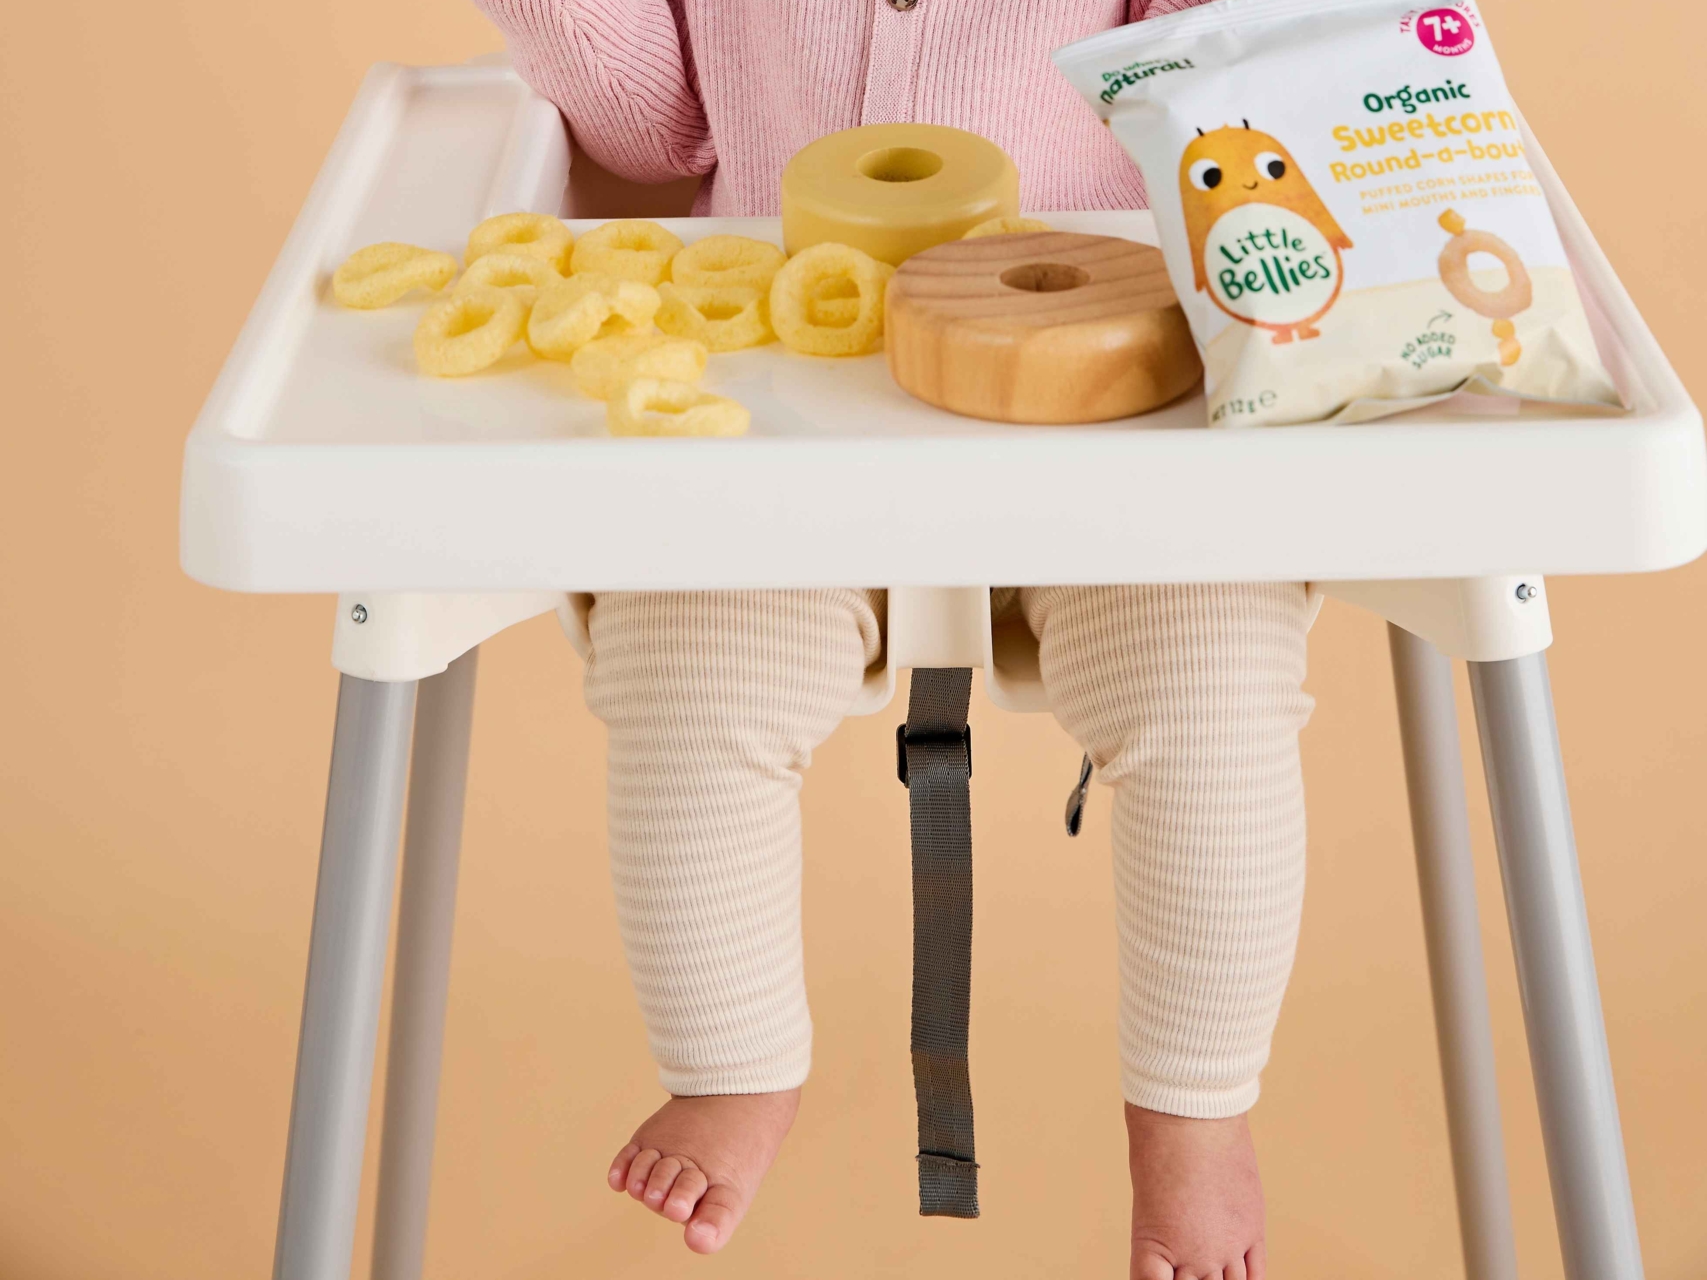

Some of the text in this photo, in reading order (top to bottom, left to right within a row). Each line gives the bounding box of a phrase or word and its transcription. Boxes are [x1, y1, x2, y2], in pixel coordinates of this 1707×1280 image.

[1423, 15, 1461, 41] 7+
[1433, 38, 1473, 54] MONTHS
[1099, 58, 1195, 106] natural!
[1363, 80, 1470, 114] Organic
[1332, 110, 1517, 152] Sweetcorn
[1359, 184, 1413, 200] PUFFED
[1416, 177, 1456, 191] CORN
[1458, 171, 1508, 186] SHAPES
[1361, 201, 1395, 215] MINI
[1398, 190, 1457, 209] MOUTHS
[1460, 187, 1488, 200] AND
[1220, 228, 1306, 264] Little
[1219, 255, 1330, 300] Bellies
[1401, 332, 1456, 360] NO ADDED
[1412, 344, 1452, 370] SUGAR
